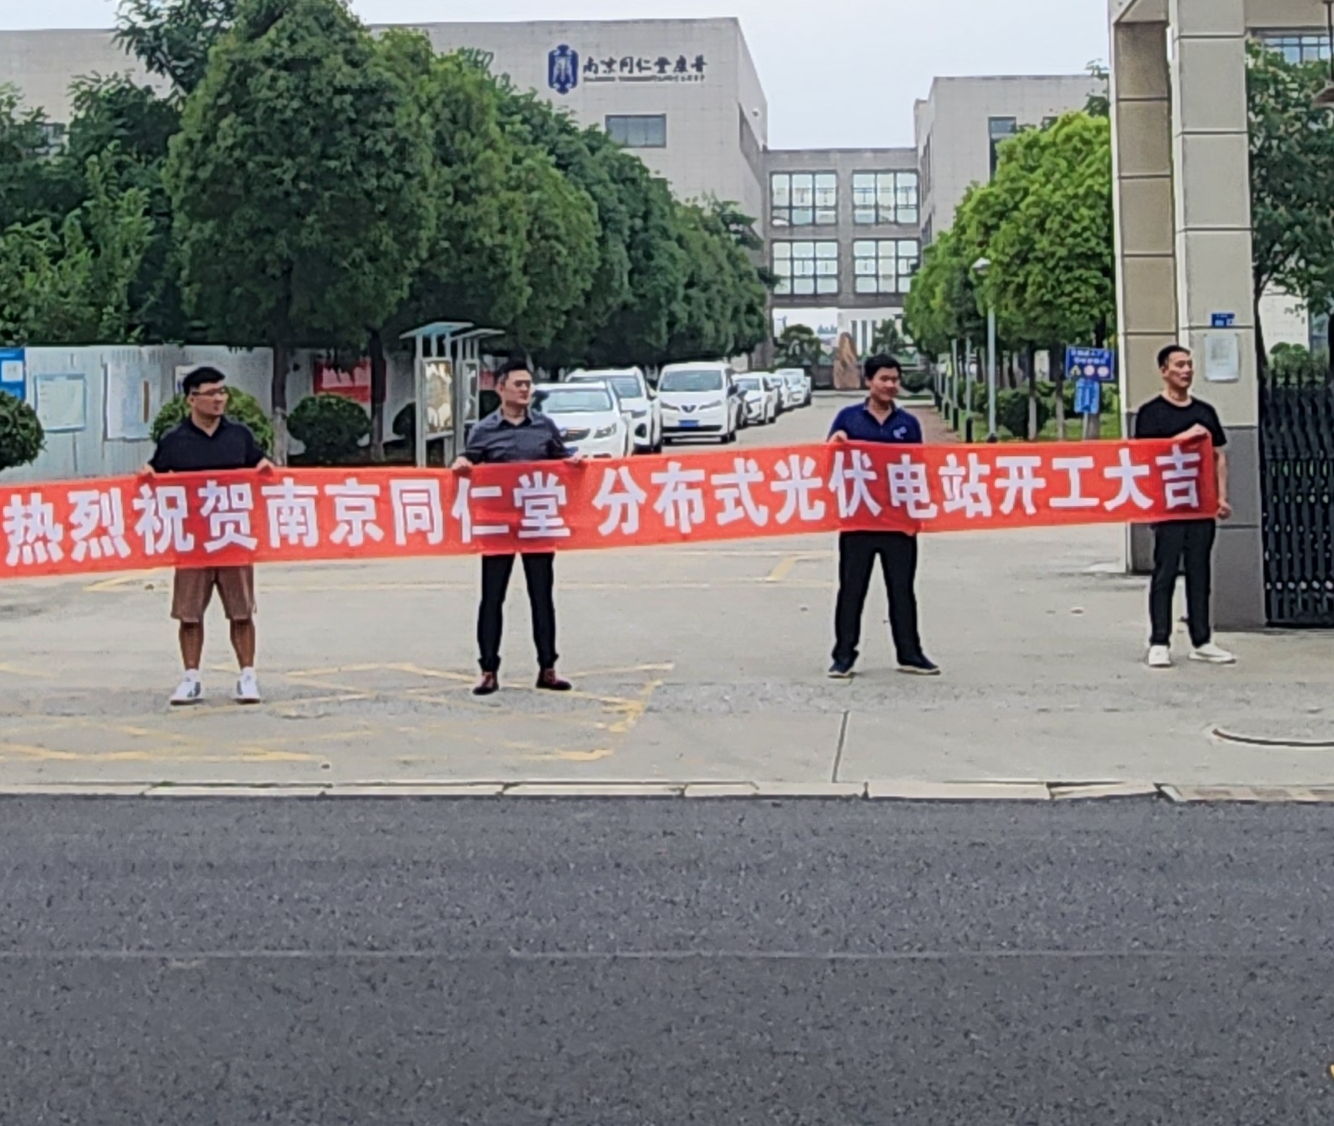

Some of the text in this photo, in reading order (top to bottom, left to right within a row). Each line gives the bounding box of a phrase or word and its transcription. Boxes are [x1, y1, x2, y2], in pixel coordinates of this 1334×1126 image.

[582, 54, 708, 74] 南京同仁堂康普
